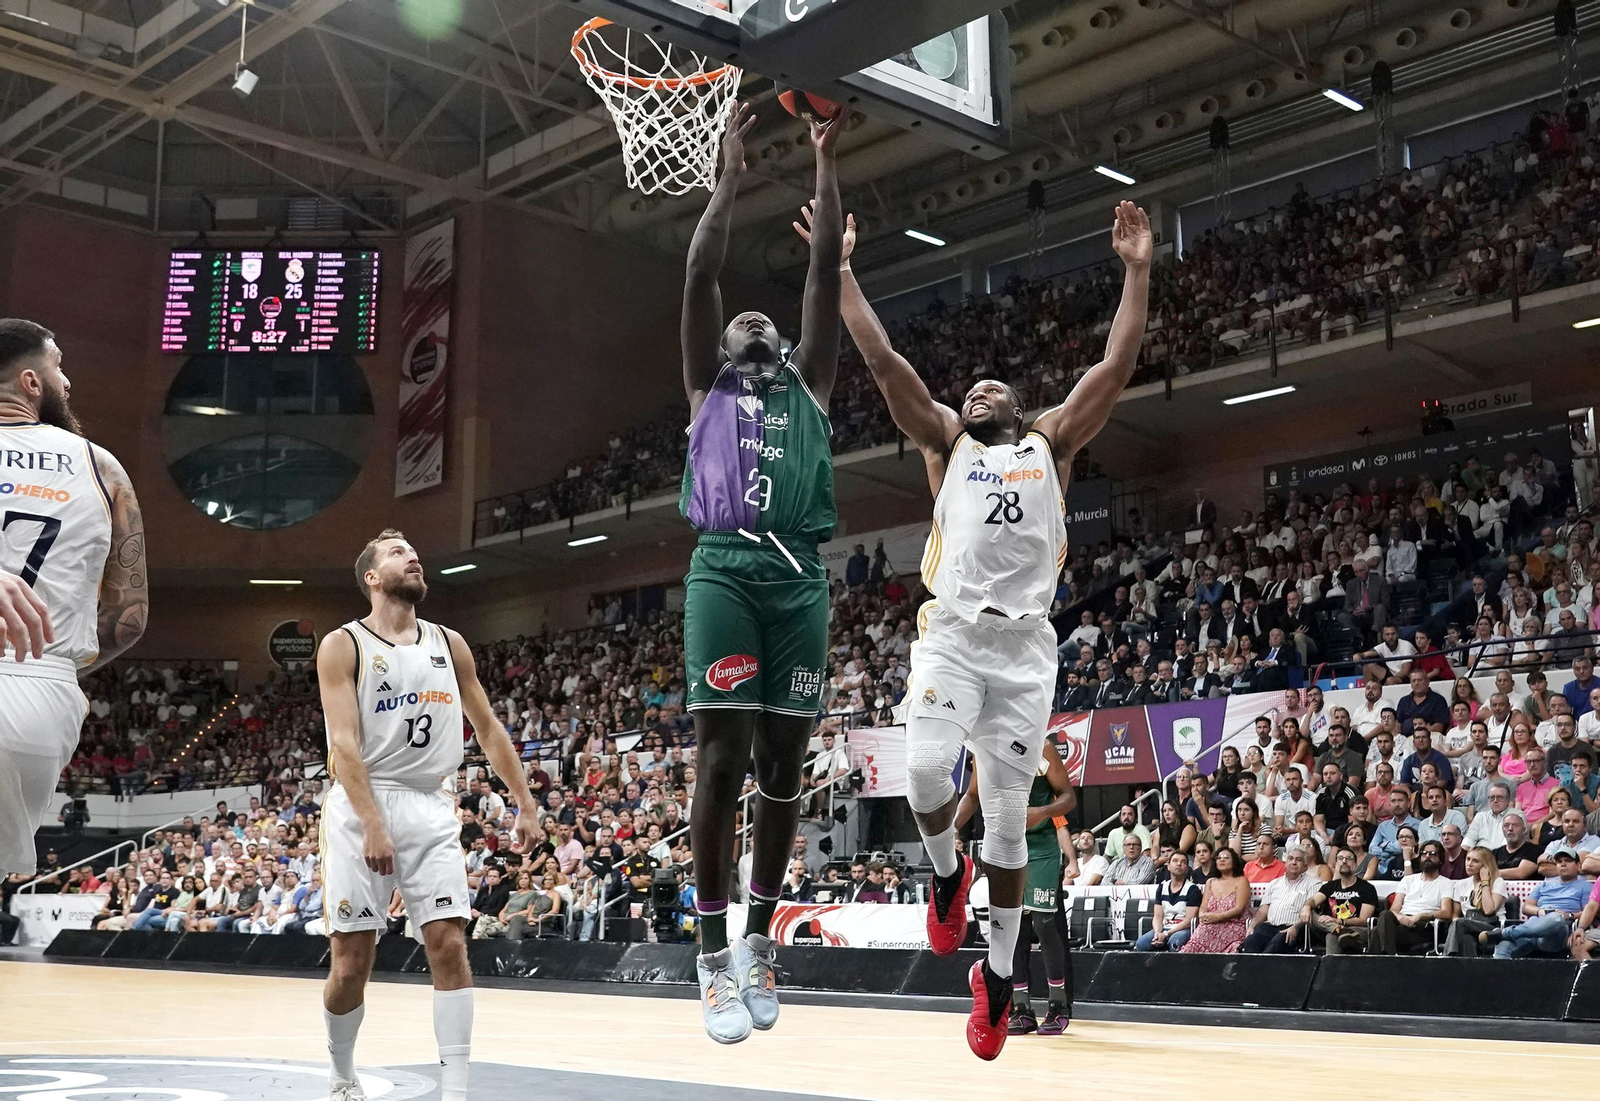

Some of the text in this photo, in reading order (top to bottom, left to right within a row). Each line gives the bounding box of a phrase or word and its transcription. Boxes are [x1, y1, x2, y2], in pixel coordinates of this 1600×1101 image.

[241, 283, 259, 299] 18
[284, 283, 303, 299] 25
[232, 319, 242, 333] 0
[299, 319, 306, 333] 1
[251, 330, 287, 344] 8:27
[1494, 392, 1518, 406] Sur
[1308, 464, 1345, 479] endesa
[744, 467, 773, 511] 29
[984, 491, 1024, 525] 28
[1074, 507, 1108, 522] Murcia
[711, 657, 758, 684] famadesa
[797, 668, 820, 683] má
[790, 677, 819, 697] laga
[375, 691, 454, 713] AUTOHERO
[404, 714, 433, 748] 13
[1105, 745, 1135, 758] UCAM
